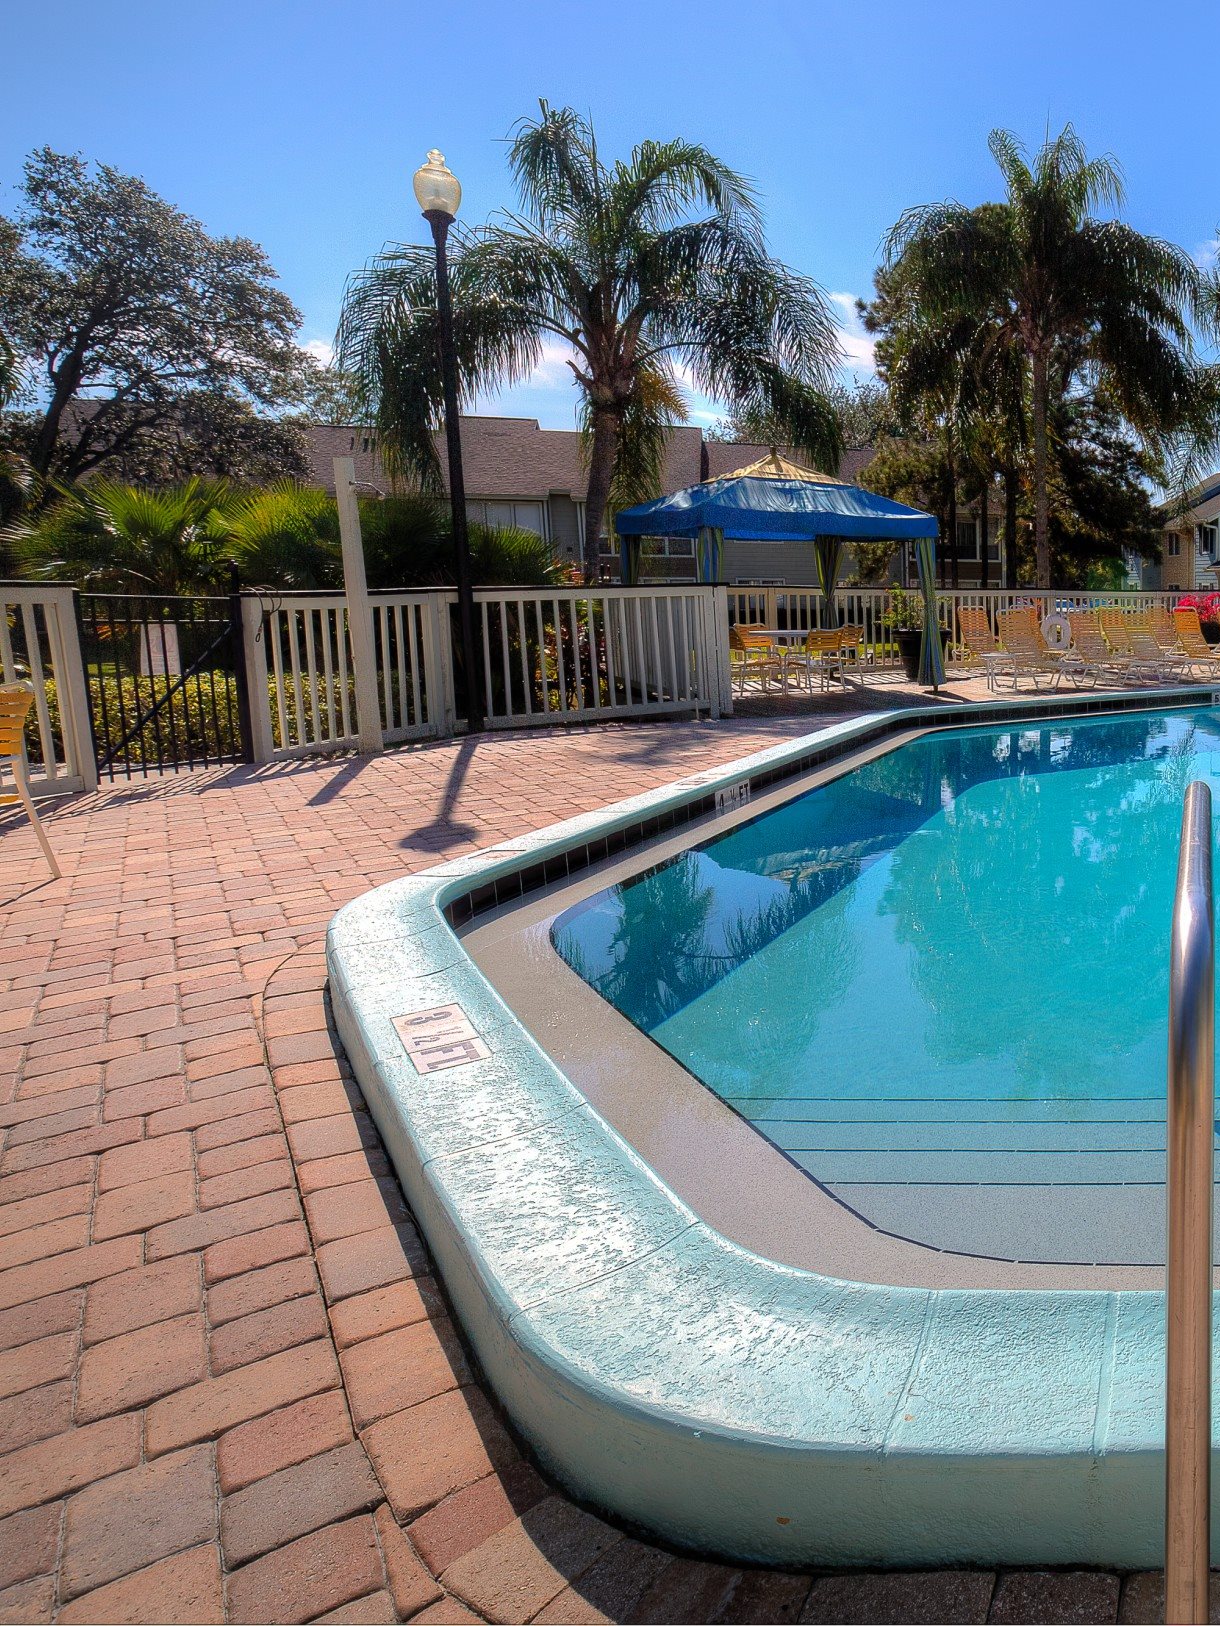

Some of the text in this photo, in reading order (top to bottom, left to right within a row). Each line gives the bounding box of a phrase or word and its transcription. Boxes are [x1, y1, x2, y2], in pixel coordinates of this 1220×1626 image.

[738, 782, 749, 799] FT
[404, 1010, 453, 1026] 3
[419, 1040, 481, 1070] FT
